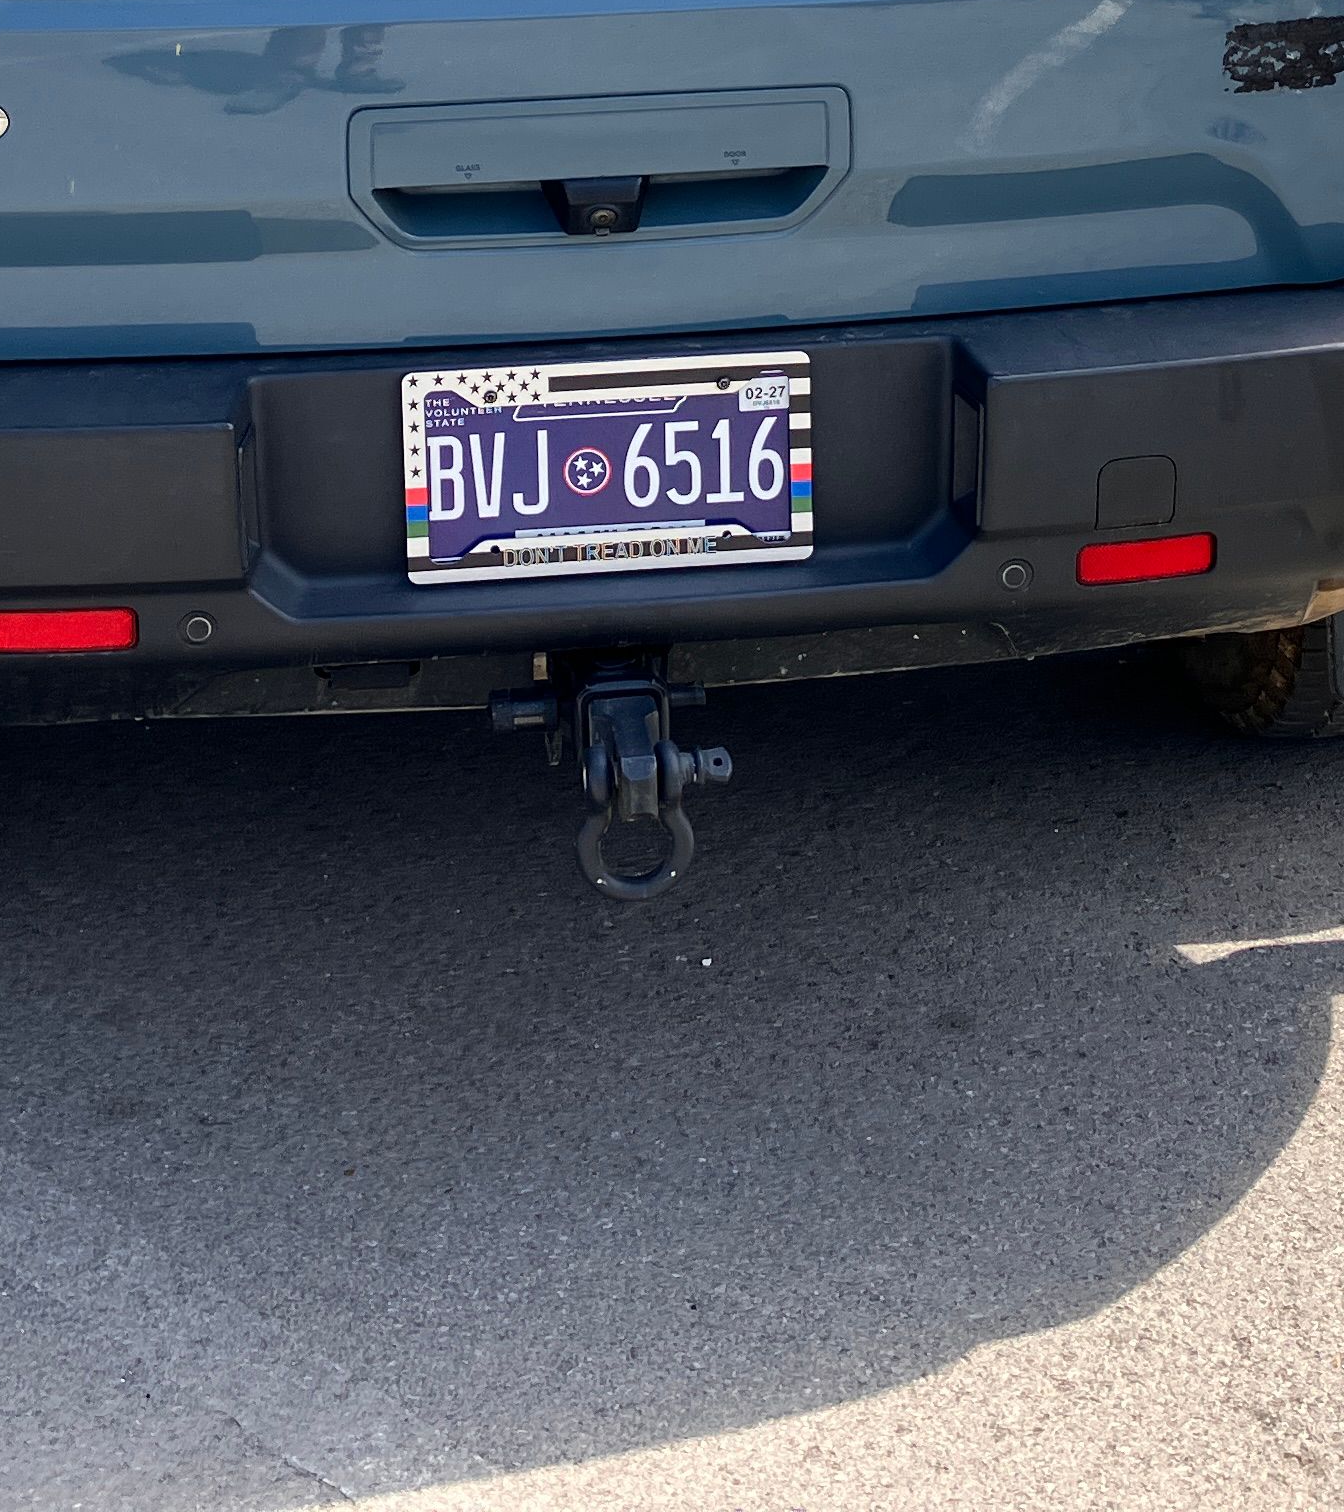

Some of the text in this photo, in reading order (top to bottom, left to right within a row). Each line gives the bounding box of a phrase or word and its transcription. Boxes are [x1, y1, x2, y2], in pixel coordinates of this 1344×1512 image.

[745, 385, 786, 400] 02-27
[425, 398, 450, 408] THE
[425, 406, 503, 418] VOLUNTEER
[425, 417, 465, 428] STATE
[427, 416, 786, 522] BVJ 6516
[503, 535, 718, 567] DON'T TREAD ON ME
